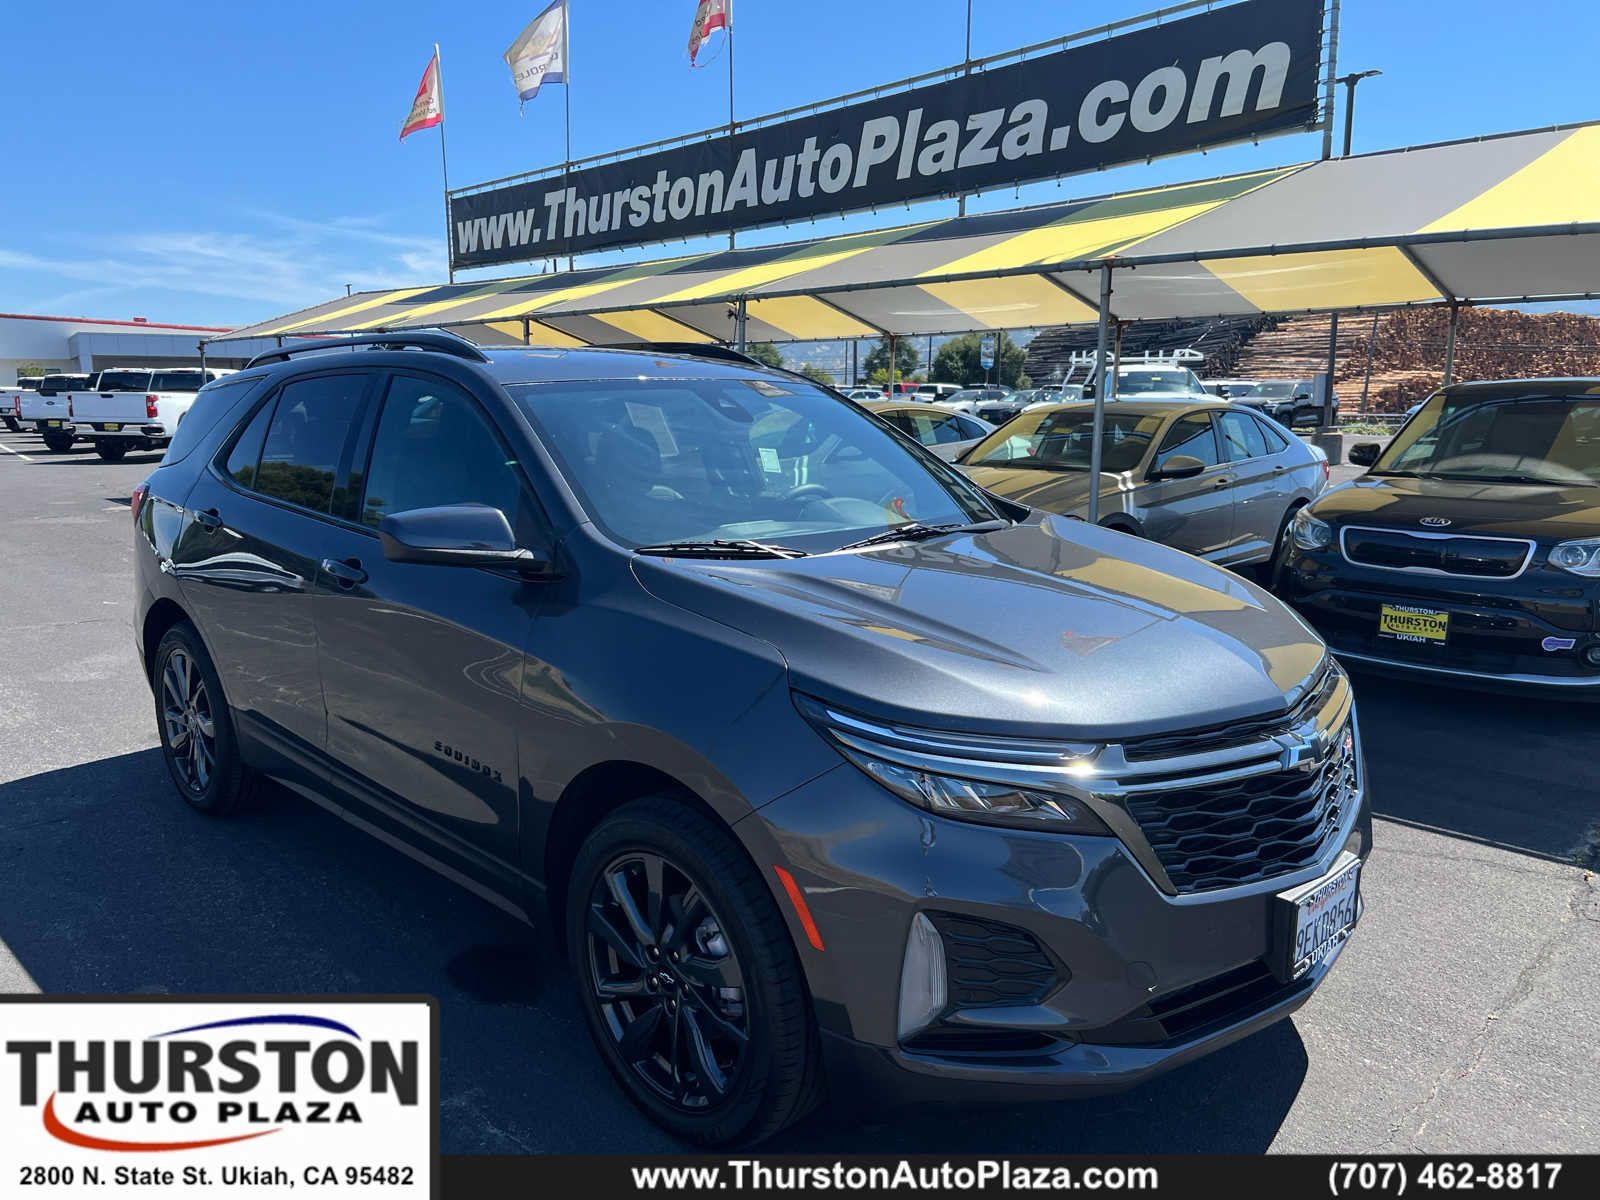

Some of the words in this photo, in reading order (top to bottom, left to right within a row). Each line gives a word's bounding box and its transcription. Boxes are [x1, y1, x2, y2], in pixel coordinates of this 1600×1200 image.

[457, 41, 1291, 255] www.ThurstonAutoPlaza.com
[1383, 614, 1447, 632] THURSTON
[1394, 604, 1434, 615] THURSTON
[1396, 634, 1426, 643] UKIAH
[434, 741, 503, 782] EQUINOX
[1296, 890, 1355, 961] 9EKD856
